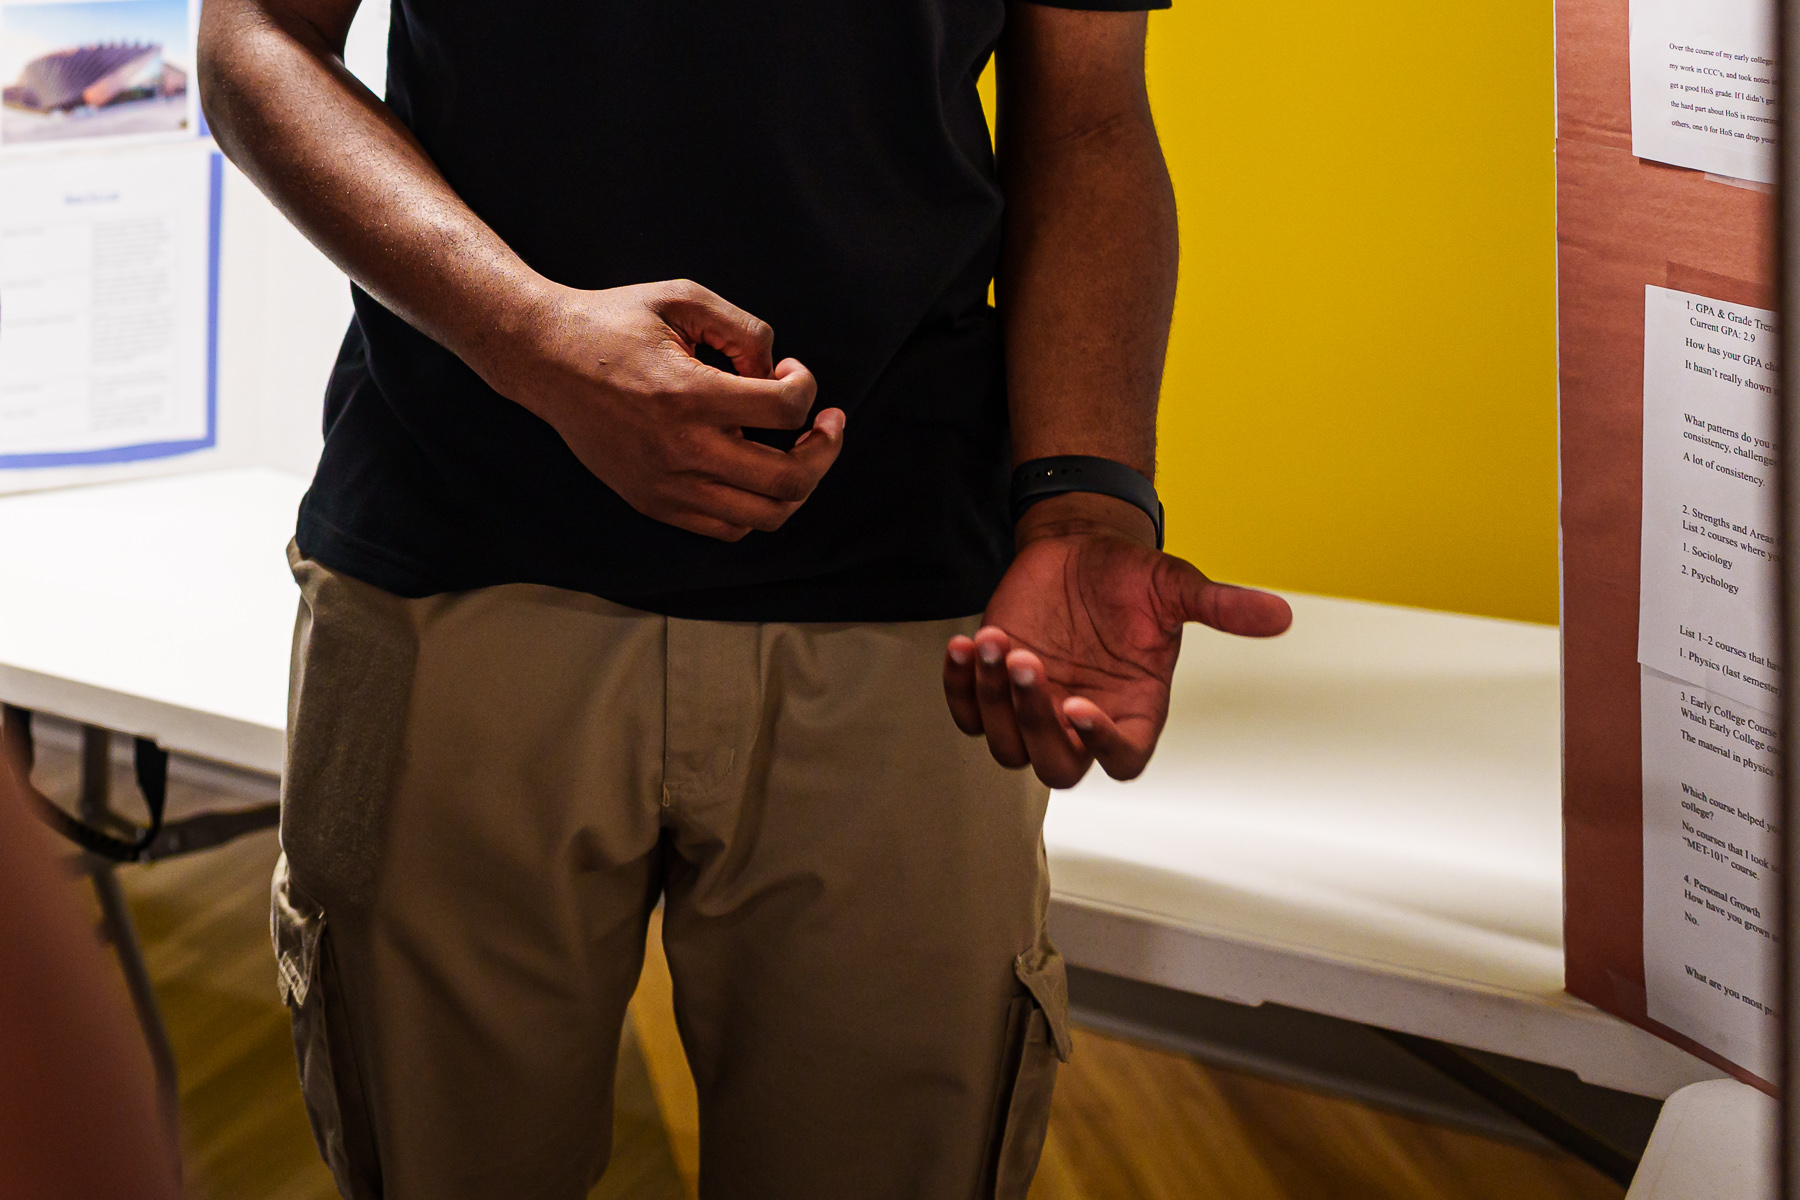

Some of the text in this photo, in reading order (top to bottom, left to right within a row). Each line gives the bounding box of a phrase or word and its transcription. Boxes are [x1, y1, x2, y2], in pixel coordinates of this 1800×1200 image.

[1669, 43, 1683, 51] Over
[1685, 45, 1693, 53] the
[1695, 48, 1714, 56] course
[1723, 52, 1732, 60] my
[1734, 53, 1749, 63] early
[1751, 56, 1773, 66] college
[1670, 63, 1678, 71] my
[1680, 64, 1695, 73] work
[1696, 66, 1702, 74] in
[1726, 71, 1737, 80] and
[1738, 73, 1751, 82] took
[1753, 76, 1770, 85] notes
[1670, 82, 1764, 103] get good HoS grade. If didn’t
[1671, 100, 1745, 120] the hard part about HoS is
[1672, 120, 1691, 129] others,
[1693, 123, 1702, 131] one
[1710, 125, 1718, 133] for
[1719, 127, 1732, 136] HoS
[1734, 131, 1744, 139] can
[1746, 131, 1760, 143] drop
[1686, 300, 1752, 326] 1. GPA & Grade
[1690, 317, 1755, 342] Current GPA: 2.9
[1686, 338, 1762, 368] How has your GPA
[1685, 360, 1691, 370] It
[1694, 362, 1717, 377] hasn’t
[1720, 372, 1742, 386] really
[1745, 379, 1771, 393] shown
[1684, 413, 1705, 428] What
[1707, 422, 1738, 439] patterns
[1741, 432, 1751, 443] do
[1754, 437, 1769, 448] you
[1684, 431, 1731, 453] consistency,
[1683, 453, 1765, 487] A lot of consistency.
[1683, 505, 1774, 544] 2. Strengths and Areas
[1683, 520, 1765, 557] List 2 courses where
[1683, 543, 1733, 570] 1. Sociology
[1682, 565, 1739, 595] 2. Psychology
[1680, 625, 1695, 638] List
[1715, 640, 1746, 658] courses
[1749, 652, 1764, 666] that
[1680, 648, 1740, 680] 1. Physics (last
[1681, 692, 1688, 702] 3.
[1690, 696, 1711, 713] Early
[1714, 706, 1745, 726] College
[1681, 707, 1764, 750] Which Early College
[1681, 729, 1774, 777] The material in physics
[1681, 802, 1714, 820] college?
[1682, 782, 1764, 828] Which course helped
[1682, 820, 1768, 868] No courses that took
[1731, 861, 1760, 880] course.
[1684, 875, 1761, 918] 4. Personal Growth
[1685, 890, 1770, 938] How have you grown
[1685, 911, 1699, 926] No.
[1685, 965, 1762, 1011] What are you most
